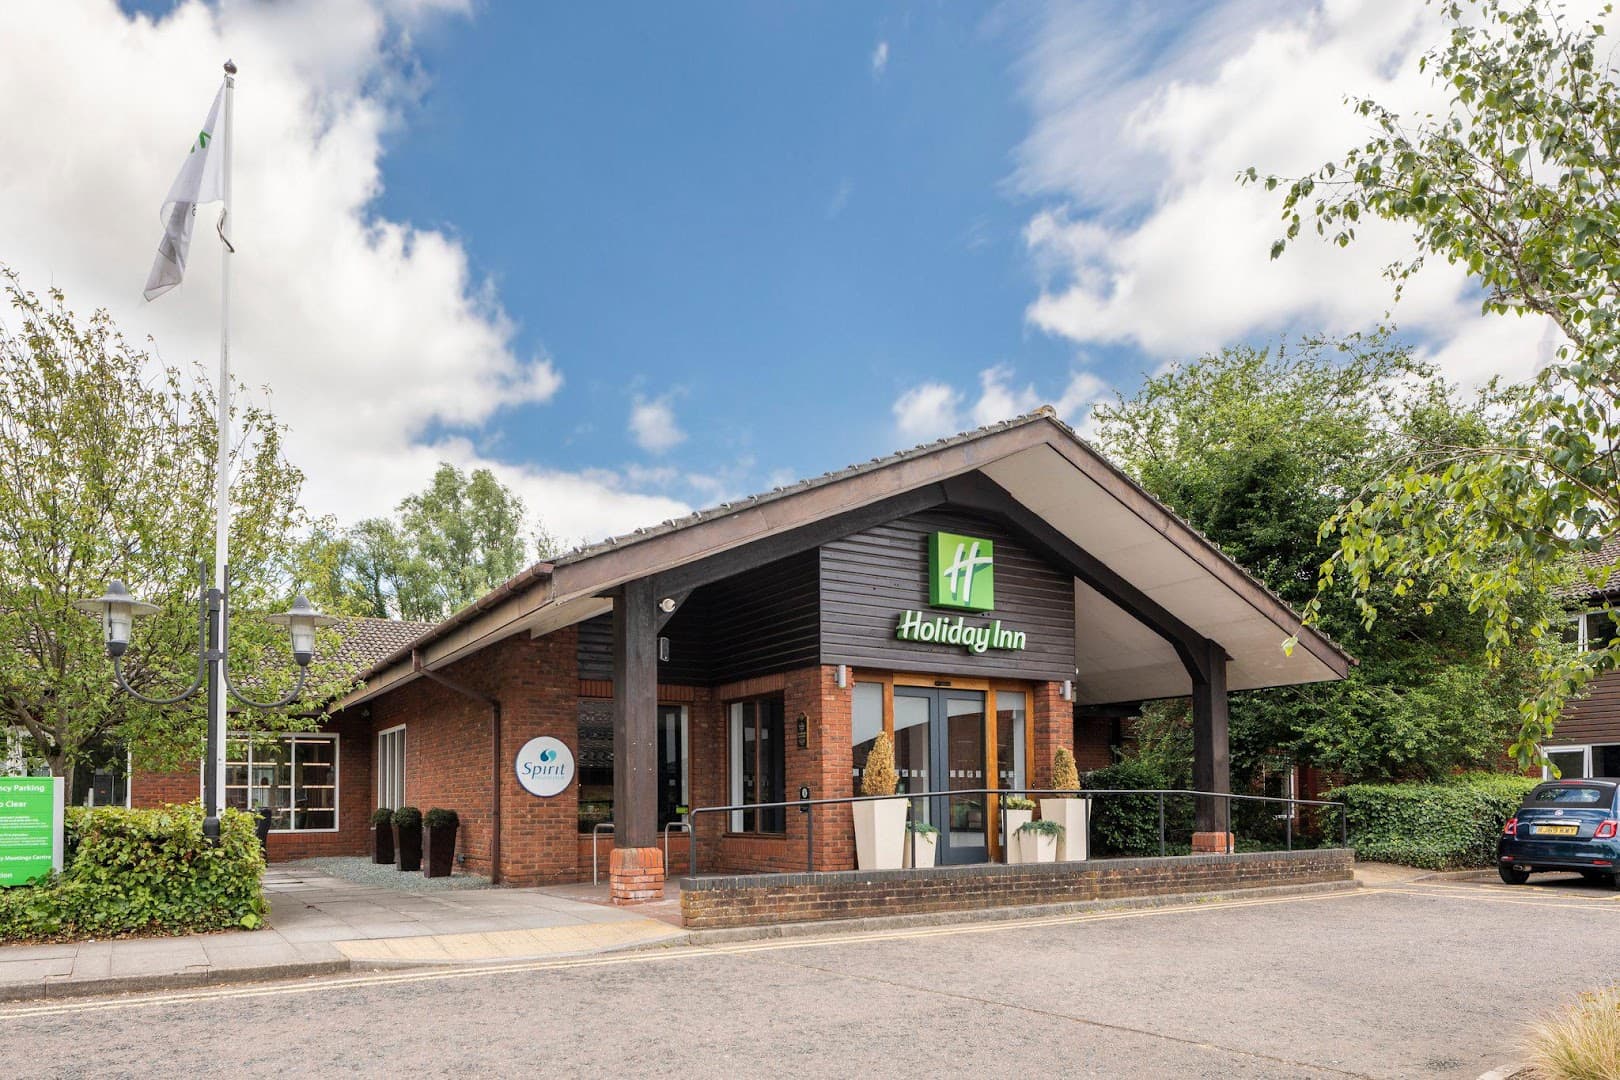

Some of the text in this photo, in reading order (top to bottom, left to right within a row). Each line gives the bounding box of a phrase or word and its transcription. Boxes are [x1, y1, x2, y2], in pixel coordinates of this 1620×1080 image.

[896, 610, 1026, 653] Holiday Inn
[521, 762, 565, 780] Spirit
[14, 784, 45, 792] Parking
